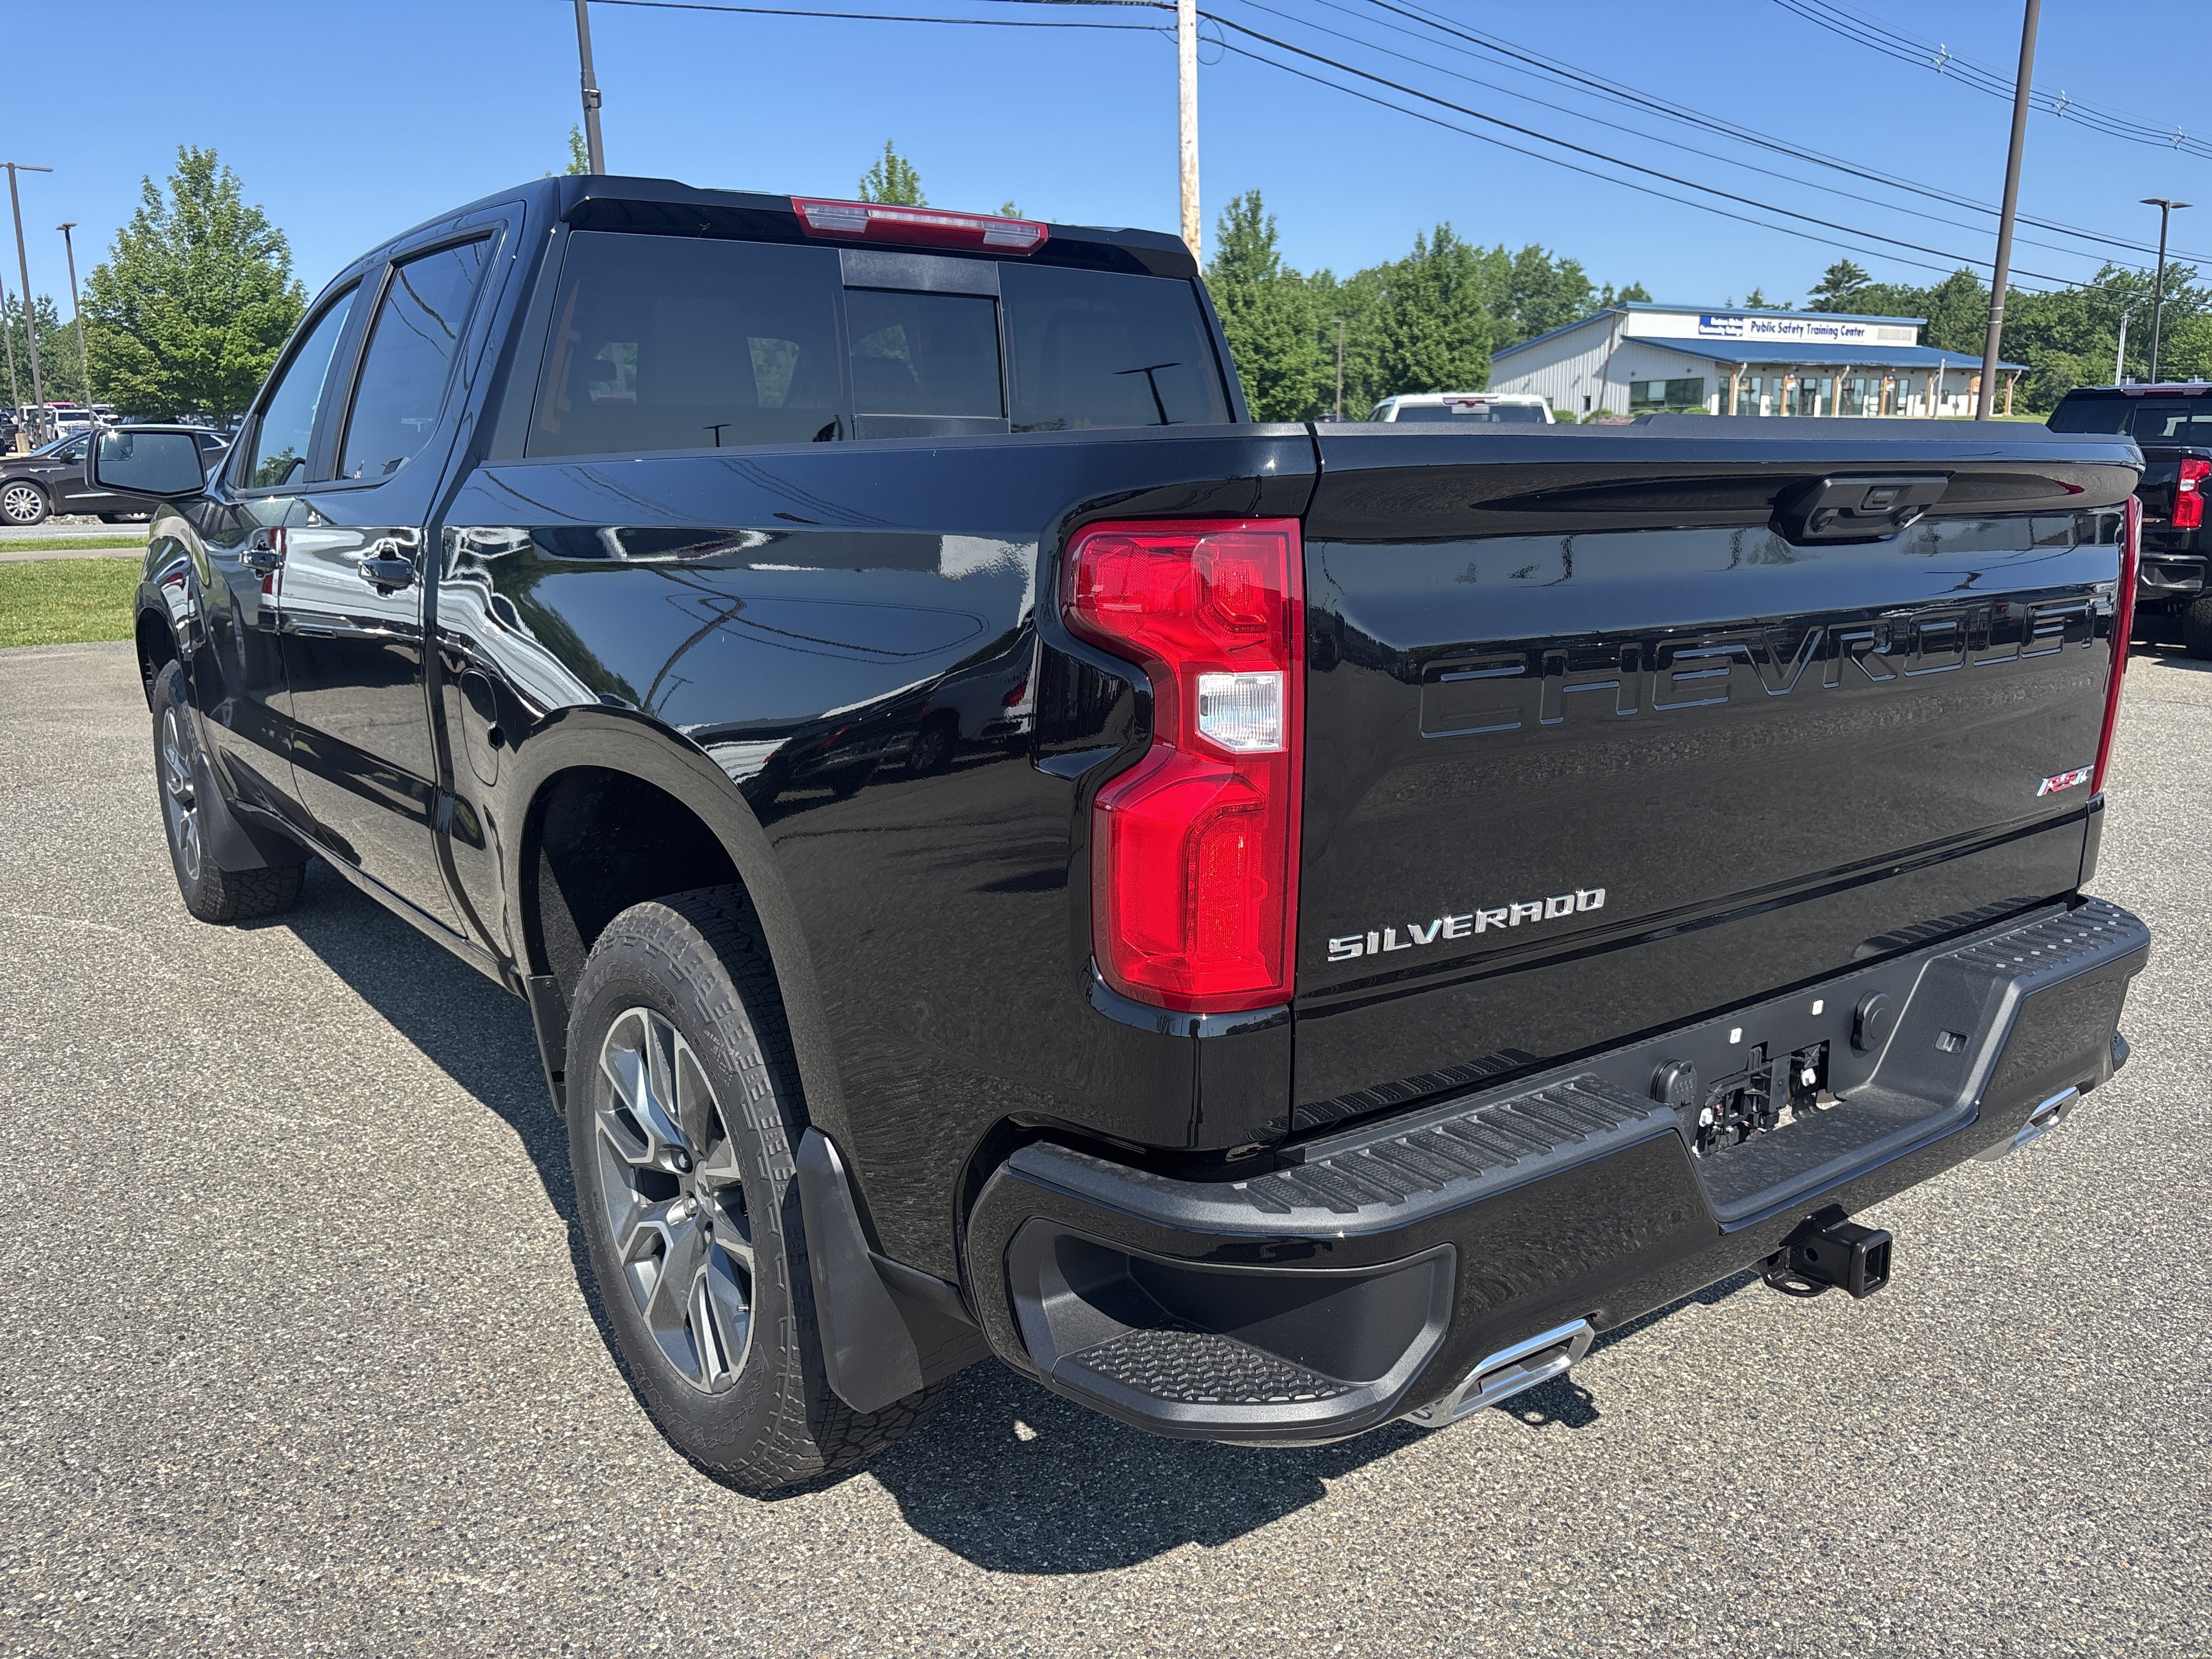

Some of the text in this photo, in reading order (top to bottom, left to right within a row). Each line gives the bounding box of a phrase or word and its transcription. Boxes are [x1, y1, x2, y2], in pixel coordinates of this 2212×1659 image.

[1751, 320, 1776, 333] Public
[1778, 321, 1804, 339] Safety
[1807, 323, 1838, 340] Training
[1840, 325, 1865, 337] Center
[1419, 592, 2111, 738] CHEVROLET
[1327, 887, 1606, 962] SILVERADO
